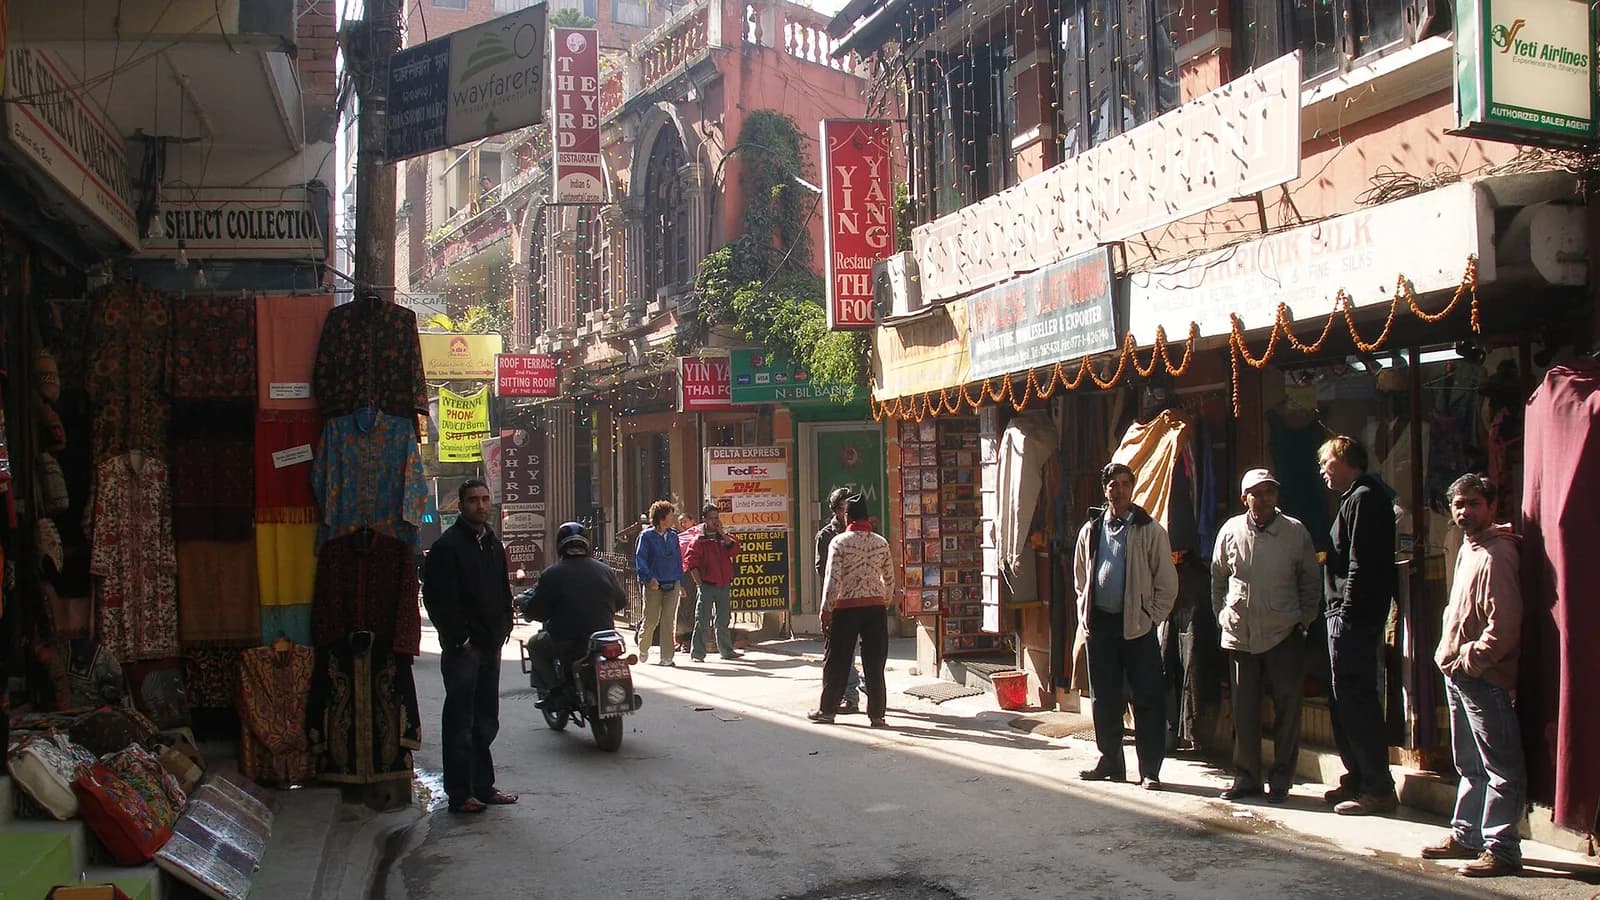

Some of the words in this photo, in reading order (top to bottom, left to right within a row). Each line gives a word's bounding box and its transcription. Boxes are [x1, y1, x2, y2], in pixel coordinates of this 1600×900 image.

[1514, 39, 1538, 58] Yeti
[1540, 43, 1588, 68] Airlines
[453, 66, 539, 107] wayfarers
[558, 57, 576, 147] THIRD
[580, 76, 598, 129] EYE
[1491, 107, 1540, 122] AUTHORIZED
[1541, 113, 1565, 127] SALES
[1566, 120, 1591, 131] AGENT
[559, 153, 598, 164] RESTAURANT
[835, 166, 860, 235] YIN
[864, 156, 888, 249] YANG
[165, 208, 222, 239] SELECT
[1311, 214, 1374, 256] SILK
[1065, 306, 1103, 331] EXPORTER
[500, 357, 520, 368] ROOF
[522, 357, 555, 369] TERRACE
[684, 363, 710, 382] YIN
[500, 377, 530, 388] SITTING
[532, 377, 556, 388] ROOM
[686, 385, 714, 396] THAI
[775, 387, 812, 400] NBIL
[713, 449, 740, 458] DELTA
[742, 448, 780, 457] EXPRESS
[505, 449, 520, 501] THIRD
[527, 455, 541, 496] EYE
[728, 466, 768, 476] FedEx
[732, 482, 761, 493] DHL
[731, 512, 780, 524] CARGO
[730, 552, 783, 563] TERNET
[740, 565, 764, 574] FAX
[757, 575, 785, 584] COPY
[746, 600, 758, 608] CD
[760, 598, 785, 607] BURN
